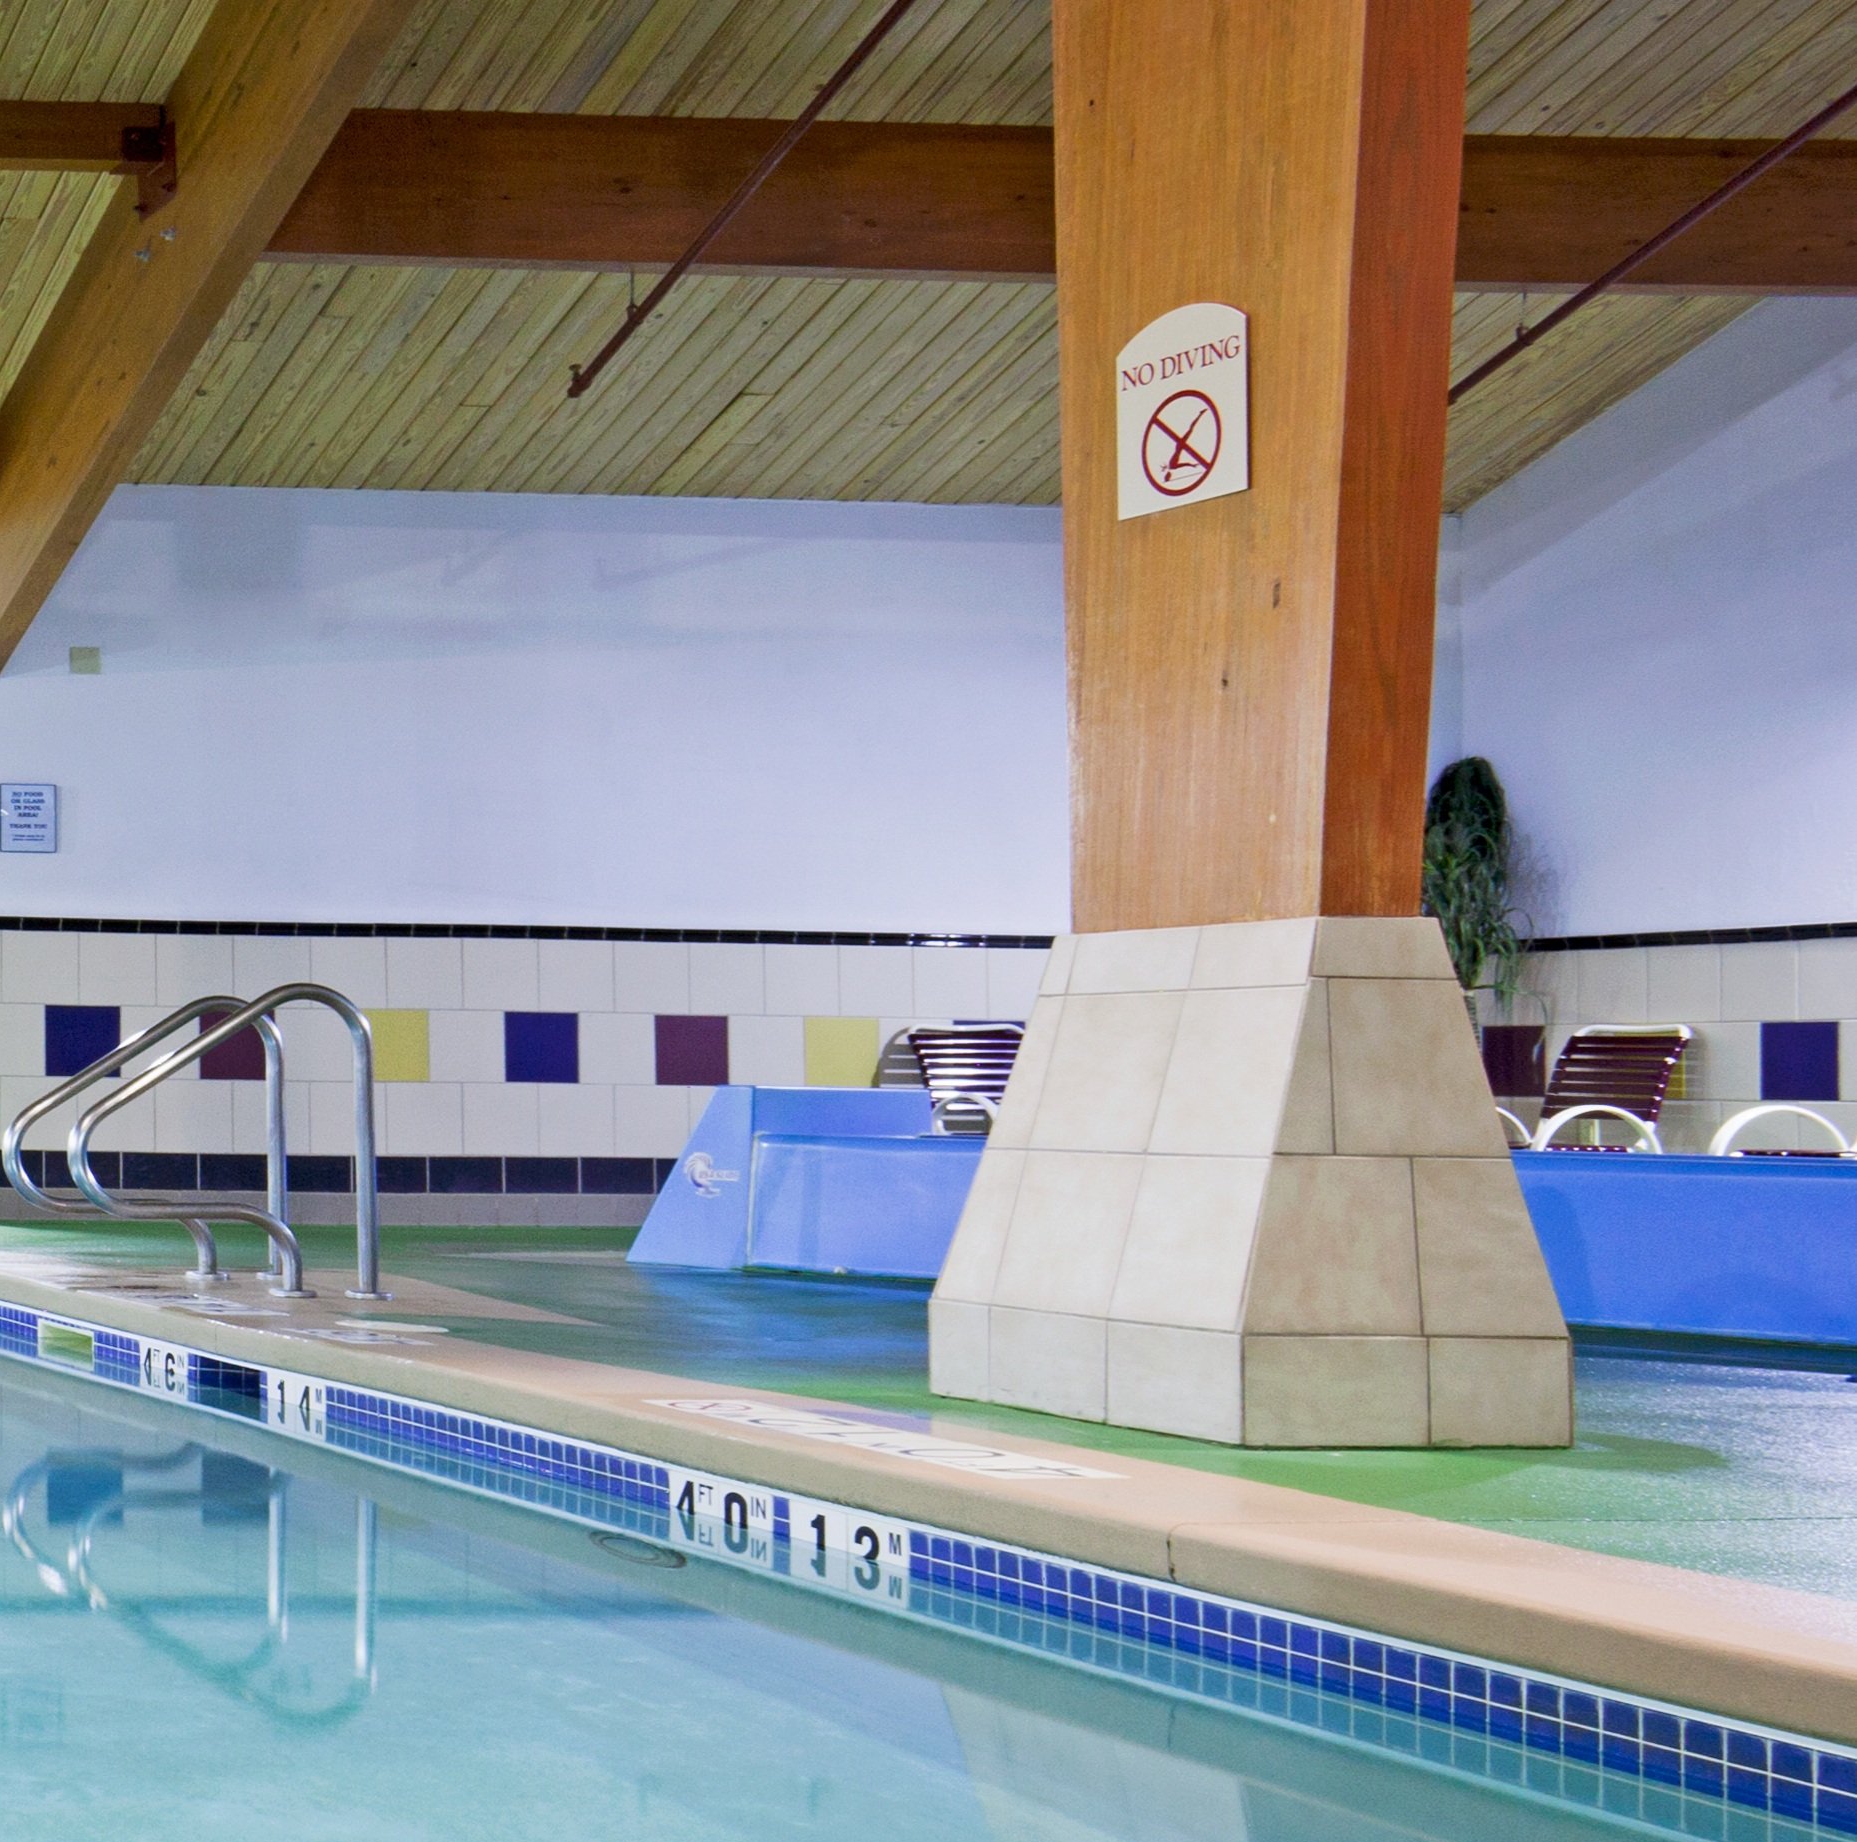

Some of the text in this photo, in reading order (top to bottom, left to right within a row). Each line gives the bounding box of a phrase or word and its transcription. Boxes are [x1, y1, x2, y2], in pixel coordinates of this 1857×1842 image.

[1121, 335, 1241, 392] NO DIVING
[699, 1484, 714, 1505] FT
[751, 1496, 766, 1520] IN
[888, 1532, 902, 1556] M
